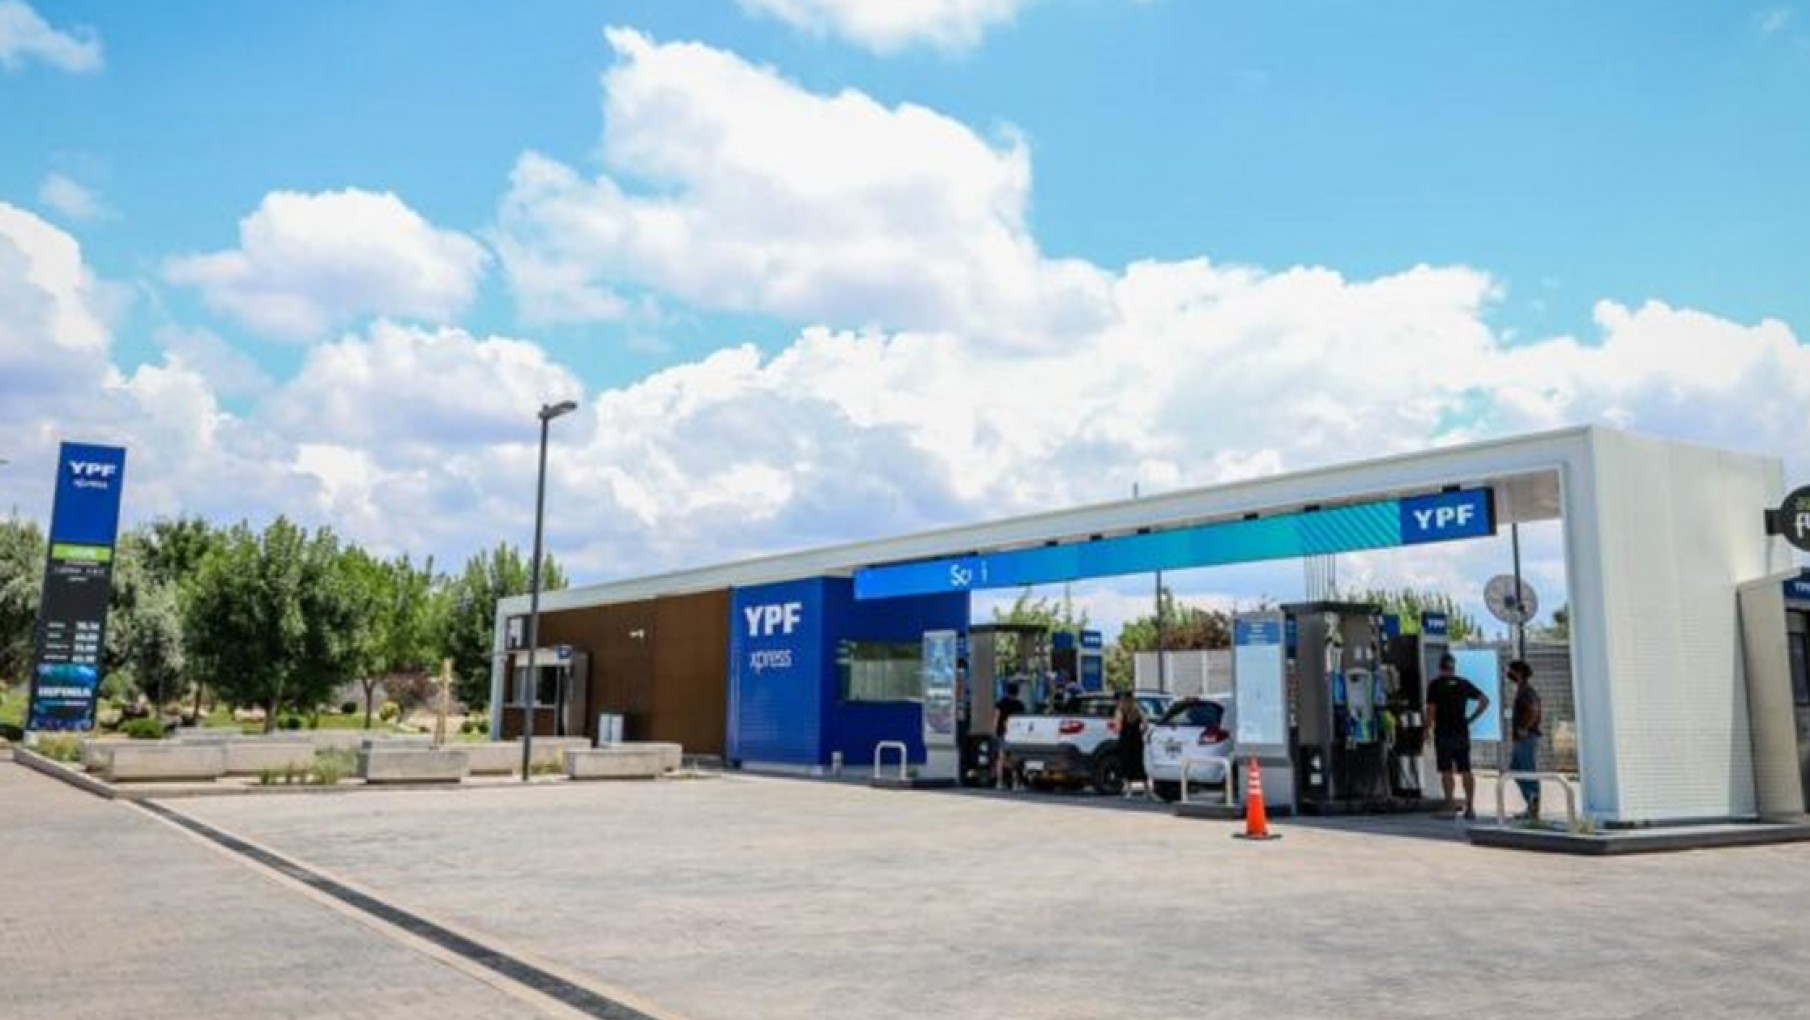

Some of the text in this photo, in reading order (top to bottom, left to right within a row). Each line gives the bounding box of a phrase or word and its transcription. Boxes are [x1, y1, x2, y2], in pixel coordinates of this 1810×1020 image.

[69, 461, 118, 476] YPF
[1413, 504, 1475, 530] YPF
[744, 601, 803, 636] YPF
[749, 649, 793, 674] xpress
